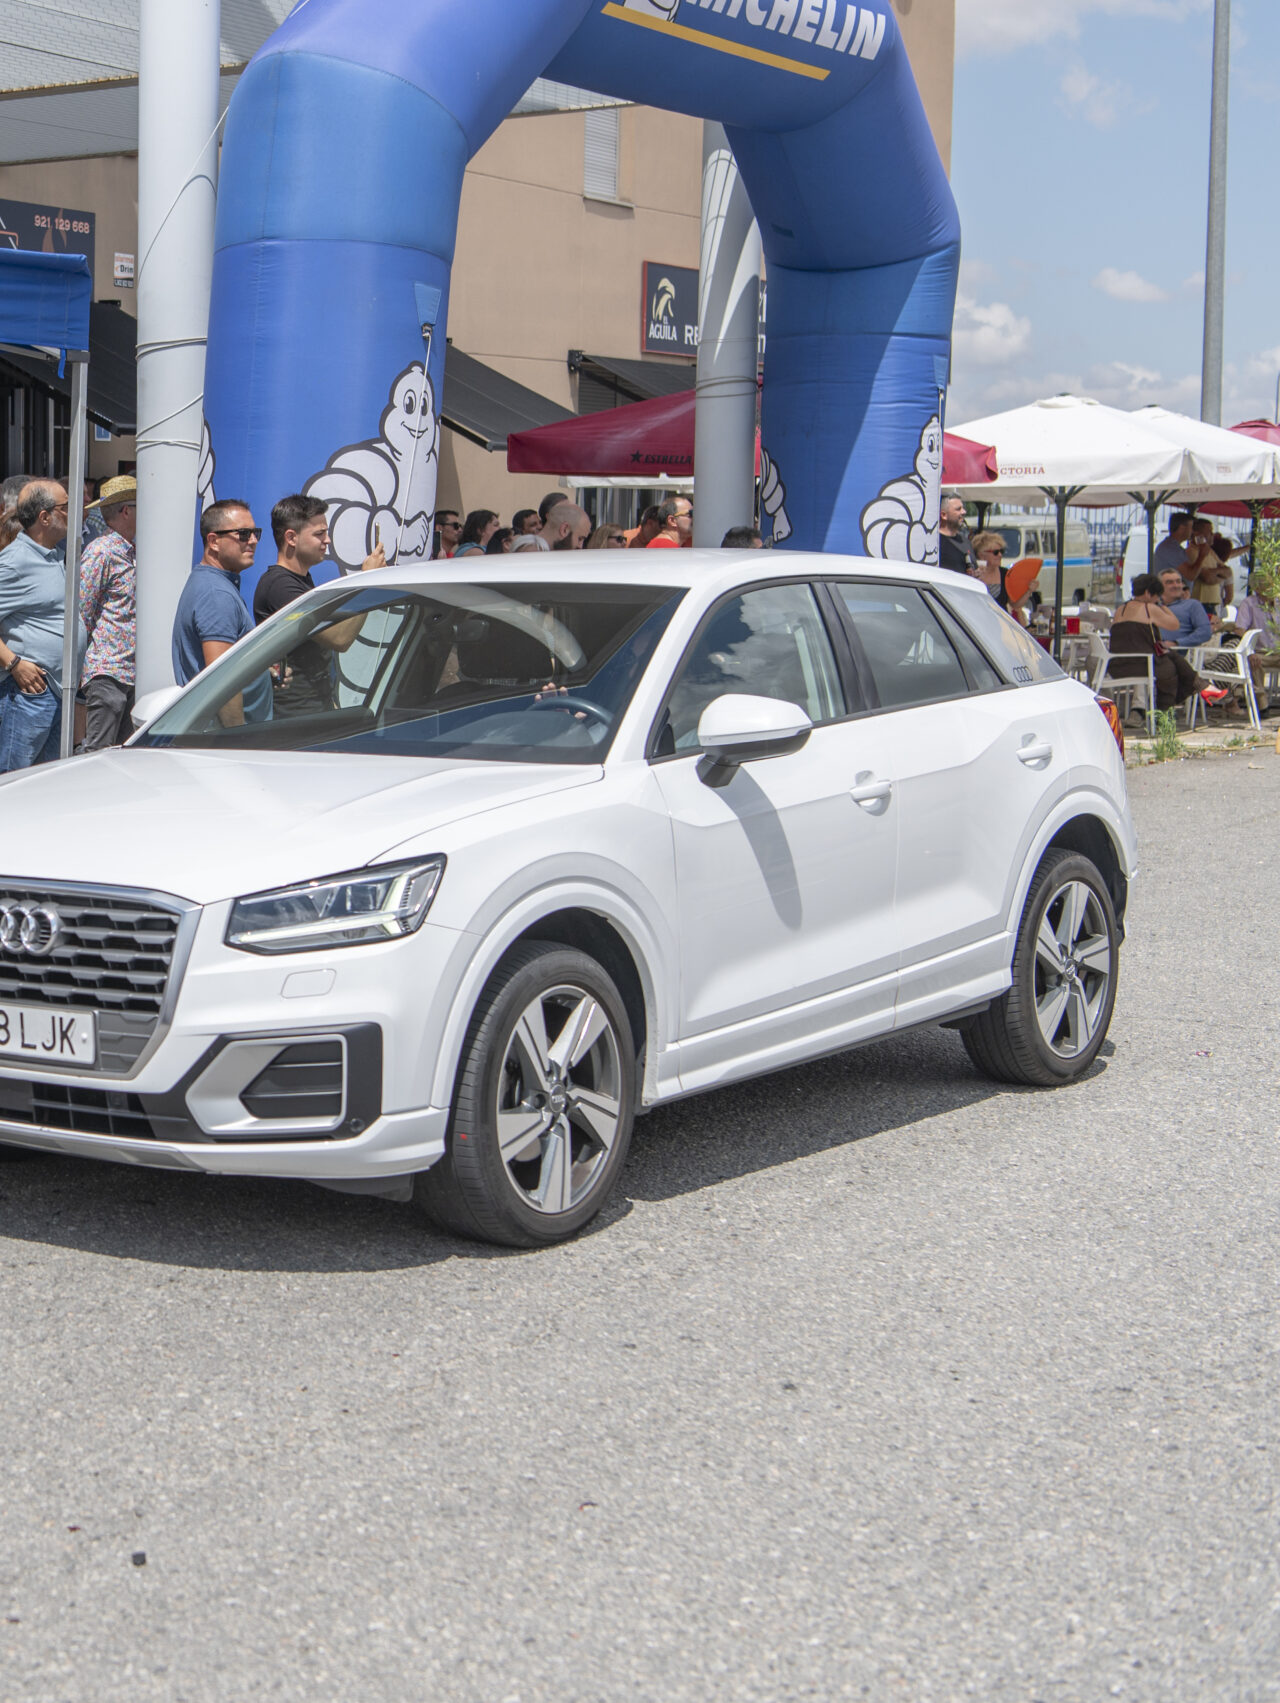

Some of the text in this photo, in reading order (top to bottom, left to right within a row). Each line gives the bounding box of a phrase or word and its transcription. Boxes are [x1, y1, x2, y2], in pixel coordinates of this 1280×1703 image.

[684, 0, 886, 61] CHELIN
[34, 214, 90, 234] 921 129 668
[644, 453, 692, 465] ESTRELLA
[1000, 466, 1046, 475] CTORIA
[20, 1012, 76, 1055] LJK
